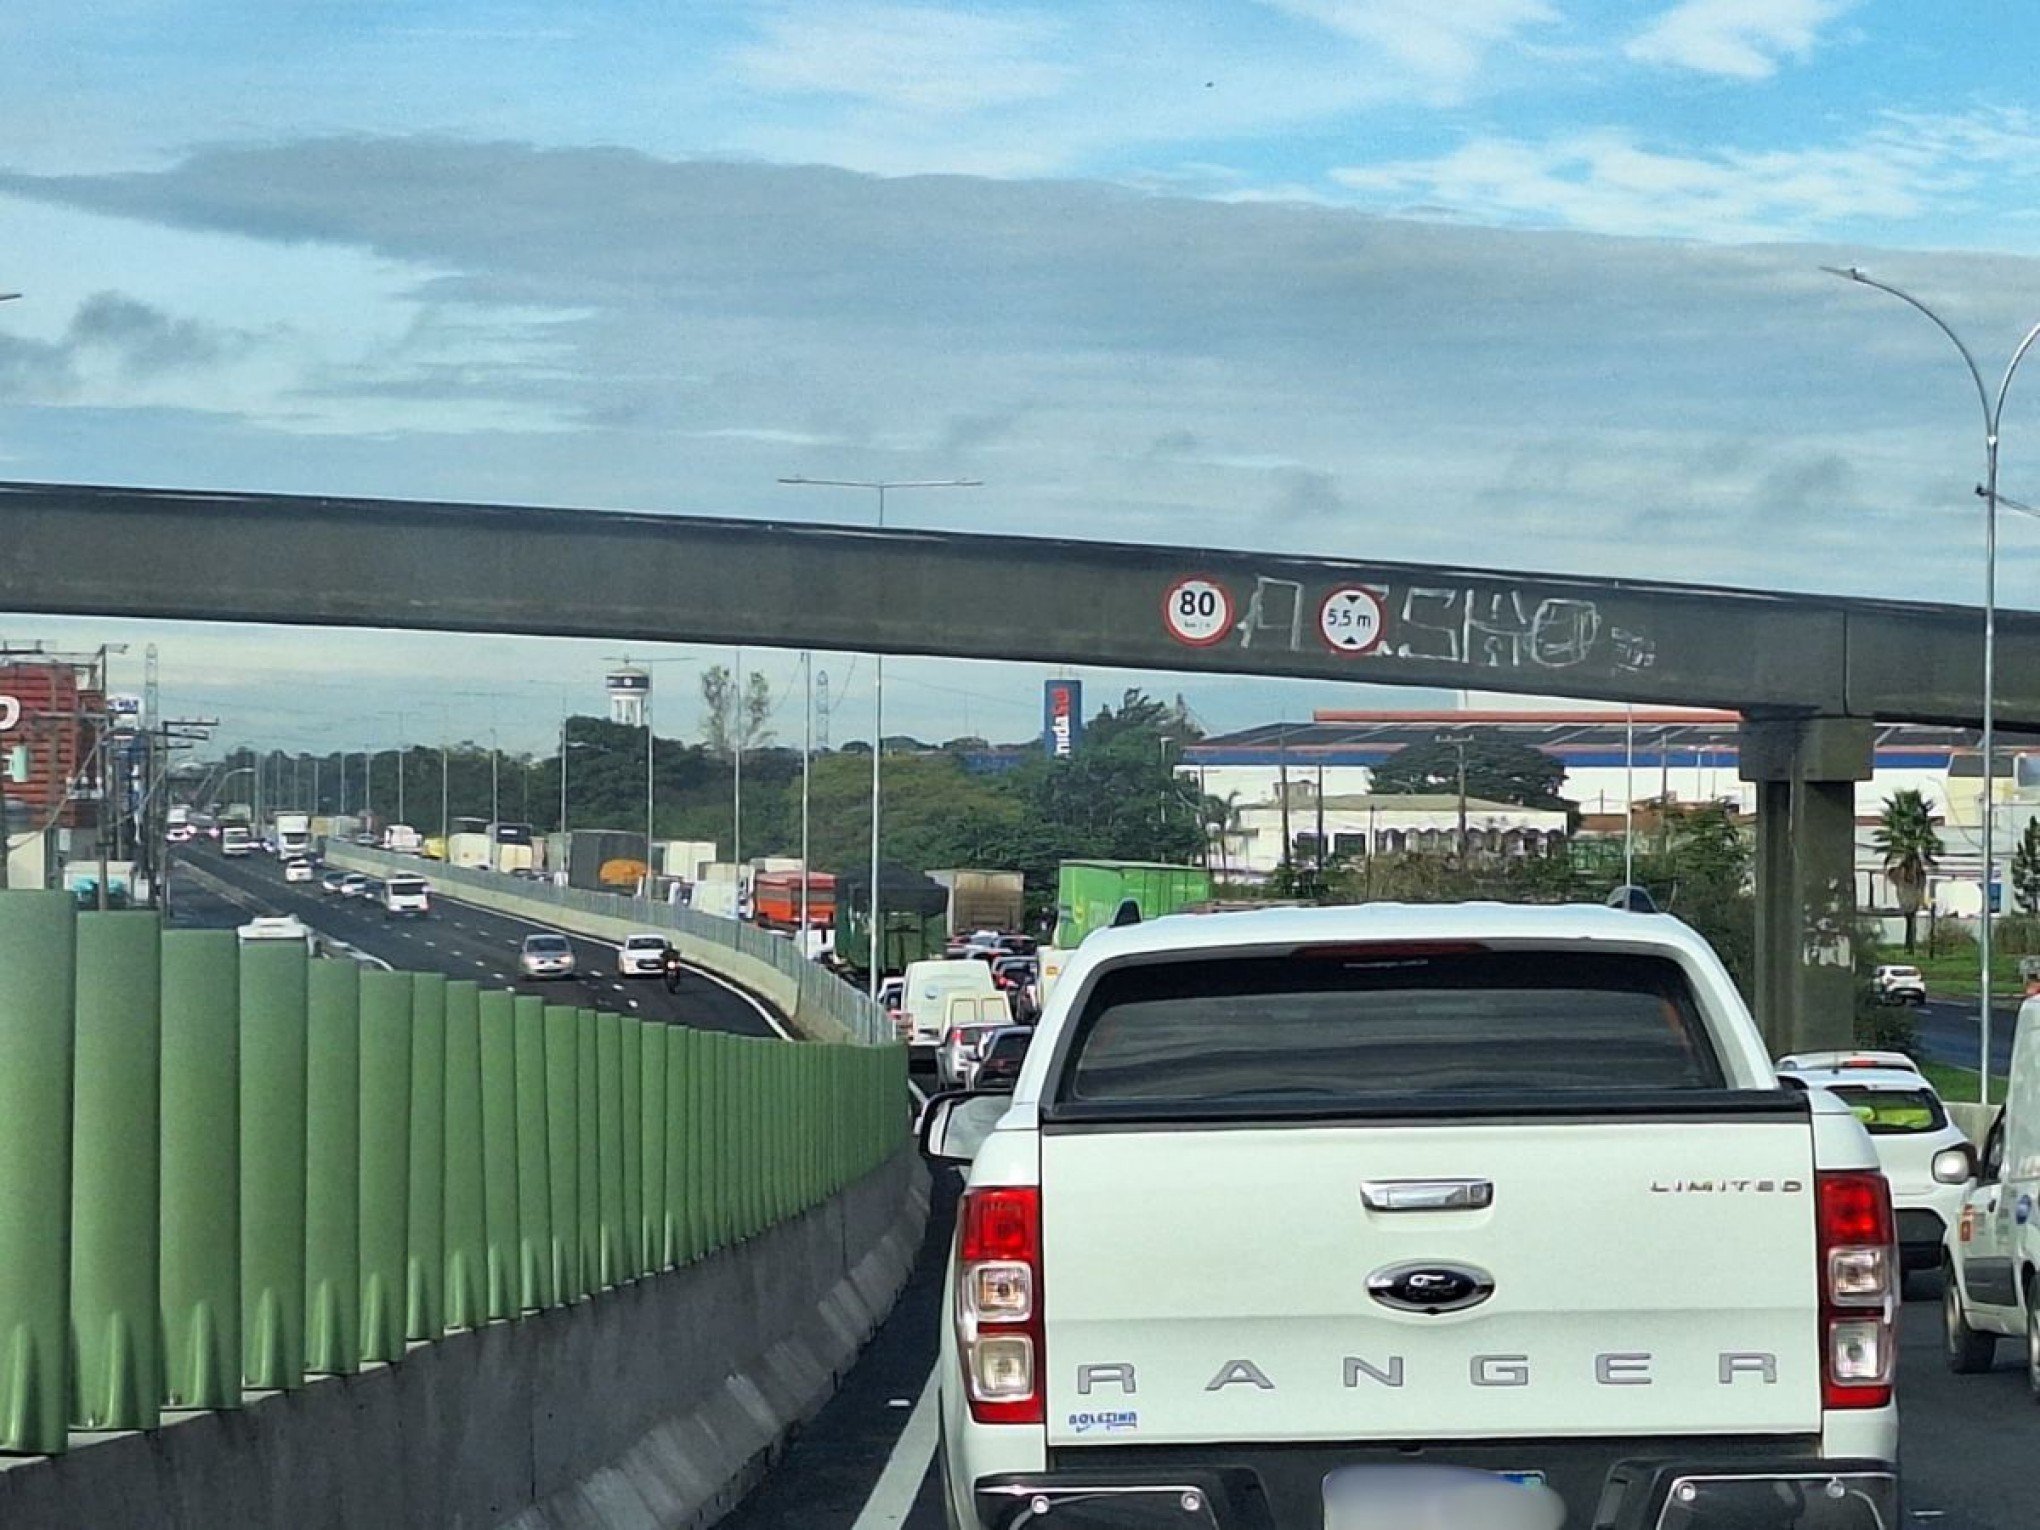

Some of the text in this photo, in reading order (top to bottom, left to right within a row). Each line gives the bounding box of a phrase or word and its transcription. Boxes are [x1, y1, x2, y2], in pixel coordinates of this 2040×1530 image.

[1179, 590, 1215, 617] 80
[1356, 614, 1371, 629] m
[1650, 1179, 1803, 1193] LIMITED
[1077, 1351, 1778, 1396] RANGER
